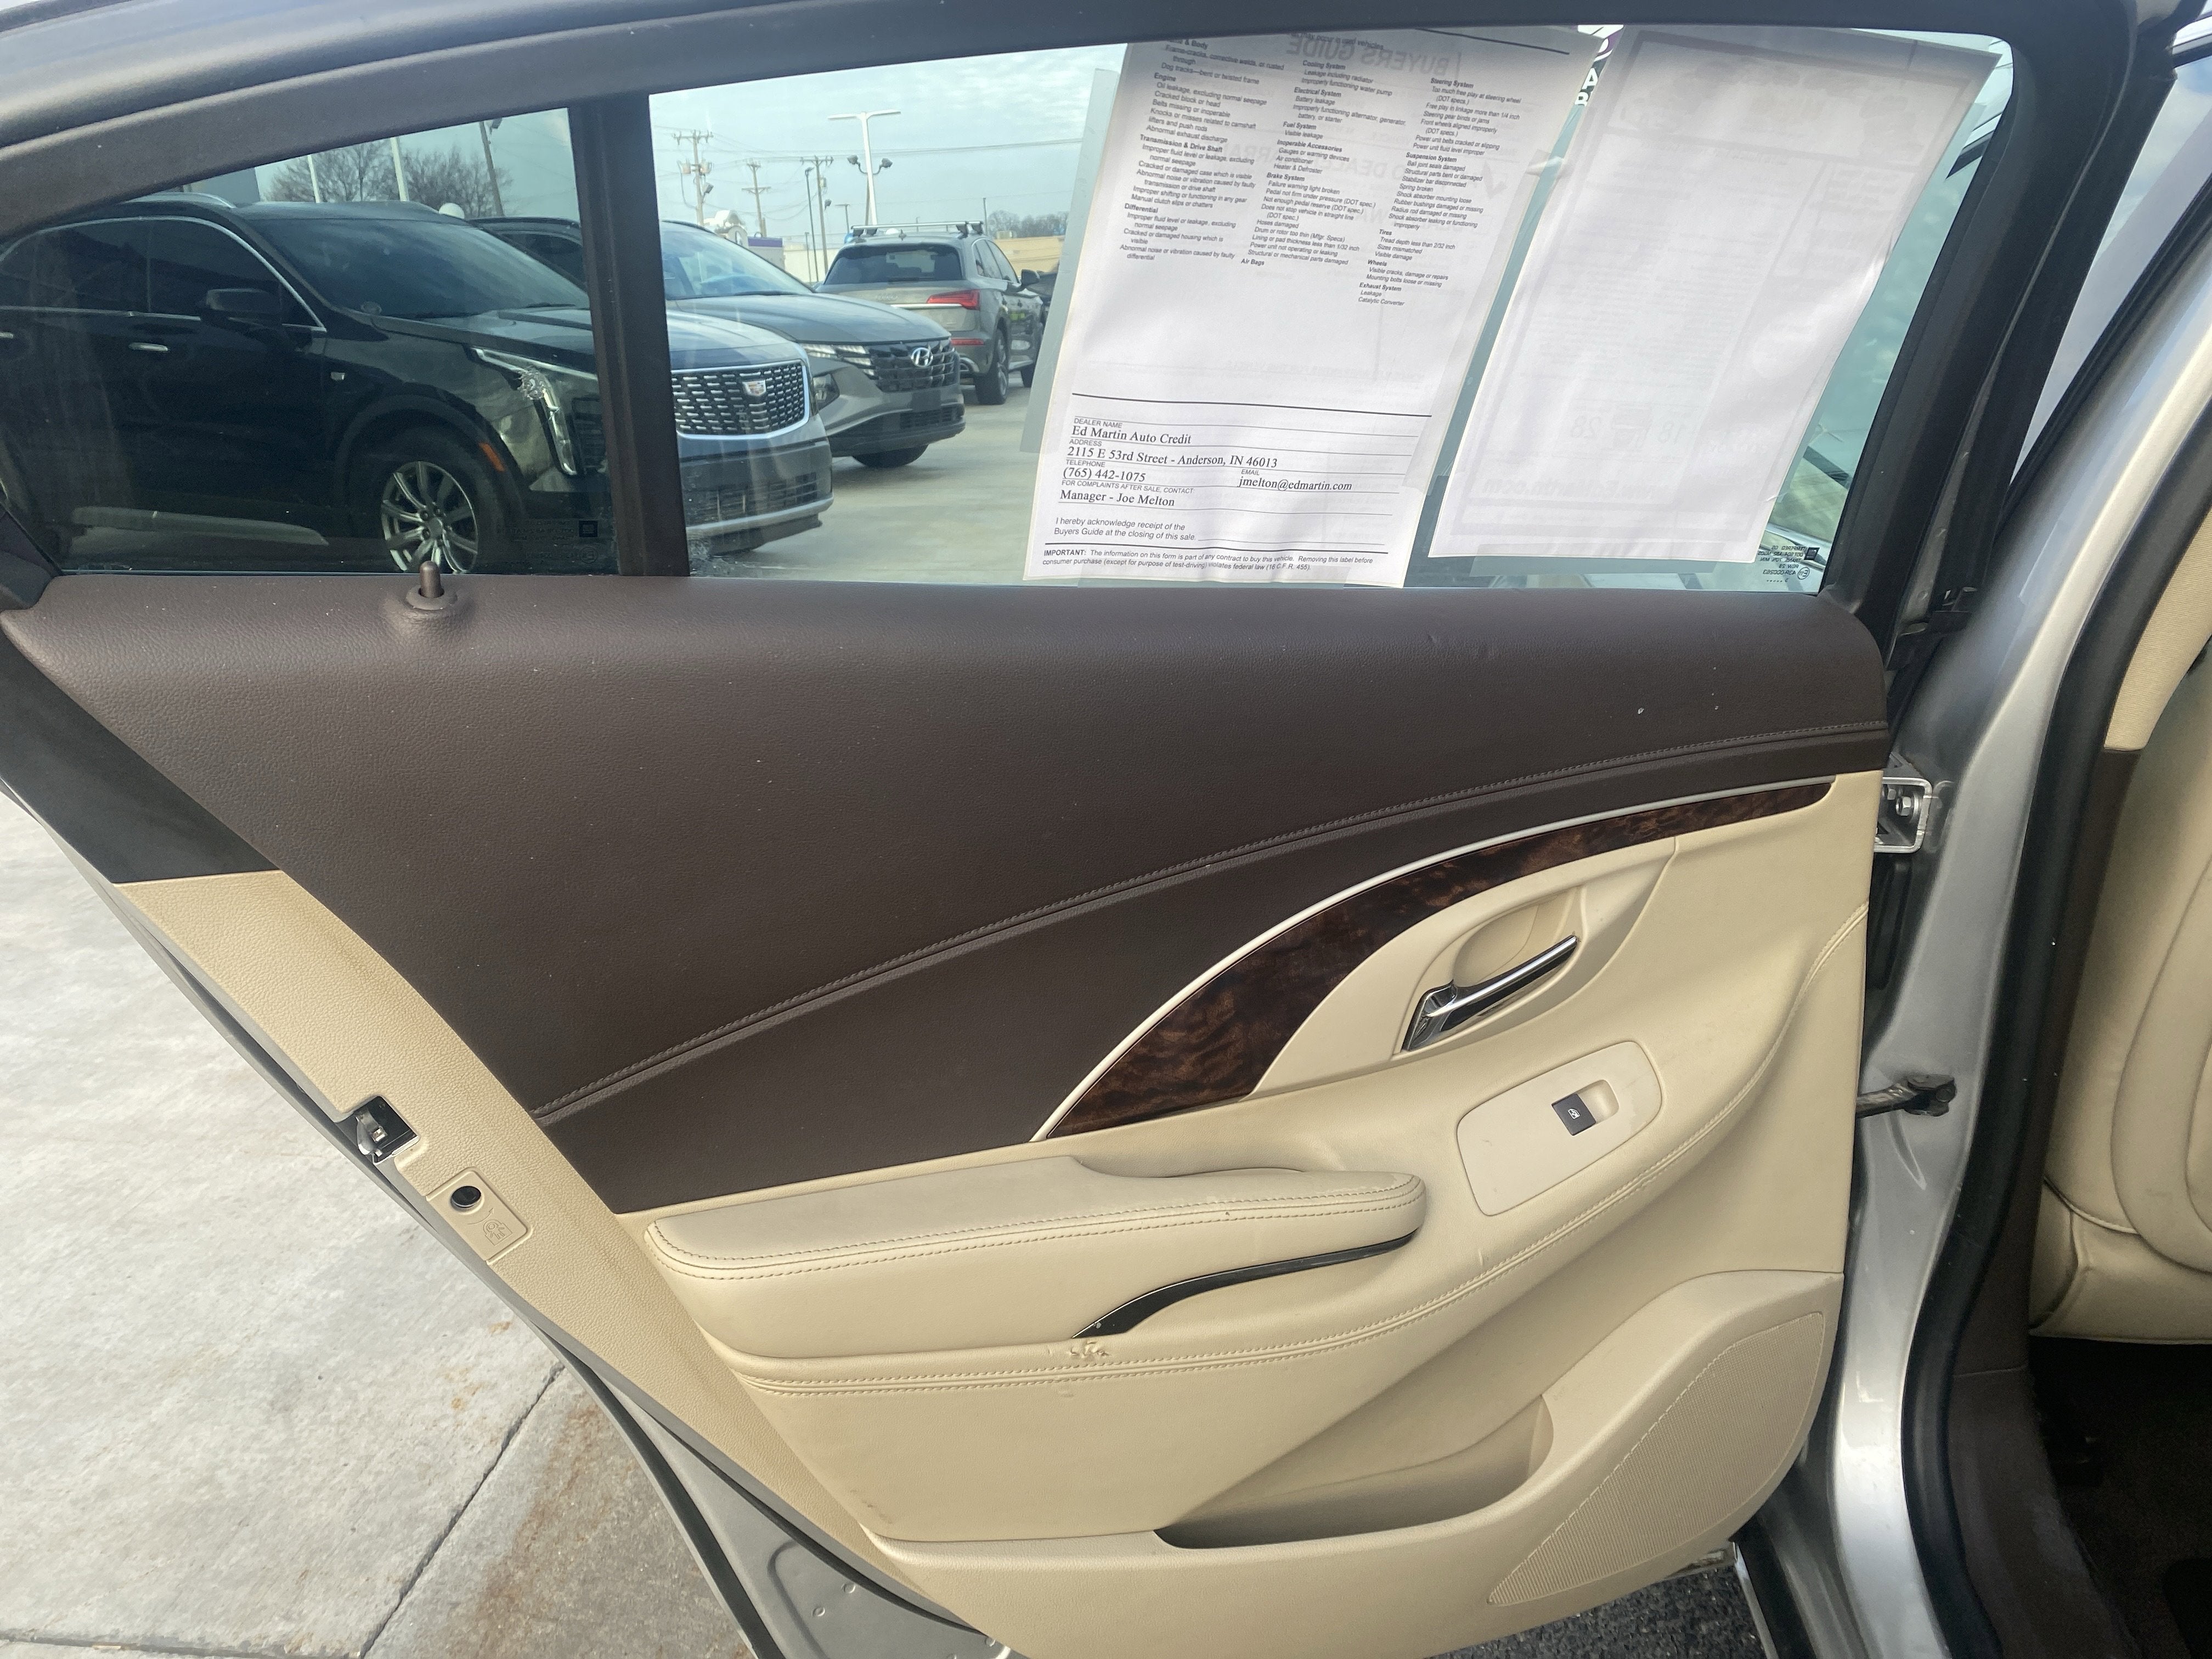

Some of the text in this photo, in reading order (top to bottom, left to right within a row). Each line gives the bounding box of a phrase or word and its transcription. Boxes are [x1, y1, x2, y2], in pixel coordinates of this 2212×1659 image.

[1302, 60, 1324, 69] Cooling
[1154, 72, 1176, 81] Engine
[1430, 77, 1474, 88] Steering System
[1320, 89, 1341, 97] System
[1140, 134, 1182, 147] Transmission
[1302, 131, 1323, 140] leakage
[1306, 142, 1342, 153] Accessories
[1406, 152, 1436, 160] Suspension
[1124, 202, 1158, 213] Differential
[1274, 221, 1299, 229] damaged
[1074, 417, 1101, 426] DEALER
[1072, 425, 1190, 444] Ed Martin Auto Credit
[1069, 438, 1102, 447] ADDRESS
[1067, 446, 1094, 457] 2115
[1097, 448, 1105, 458] E
[1109, 450, 1133, 460] 53rd
[1136, 452, 1167, 464] Street
[1177, 455, 1225, 466] Anderson,
[1229, 455, 1244, 465] IN
[1246, 456, 1277, 467] 46013
[1066, 459, 1105, 467] TELEPHONE
[1063, 467, 1146, 482] (765) 442-1075
[1077, 480, 1119, 488] COMPLAINTS
[1238, 477, 1352, 490] jmelton@edmartin.com
[1060, 489, 1107, 503] Manager
[1116, 493, 1135, 503] Joe
[1137, 494, 1174, 506] Melton
[1060, 517, 1085, 526] hereby
[1087, 518, 1135, 528] acknowledge
[1054, 527, 1079, 536] Buyers
[1128, 530, 1154, 539] closing
